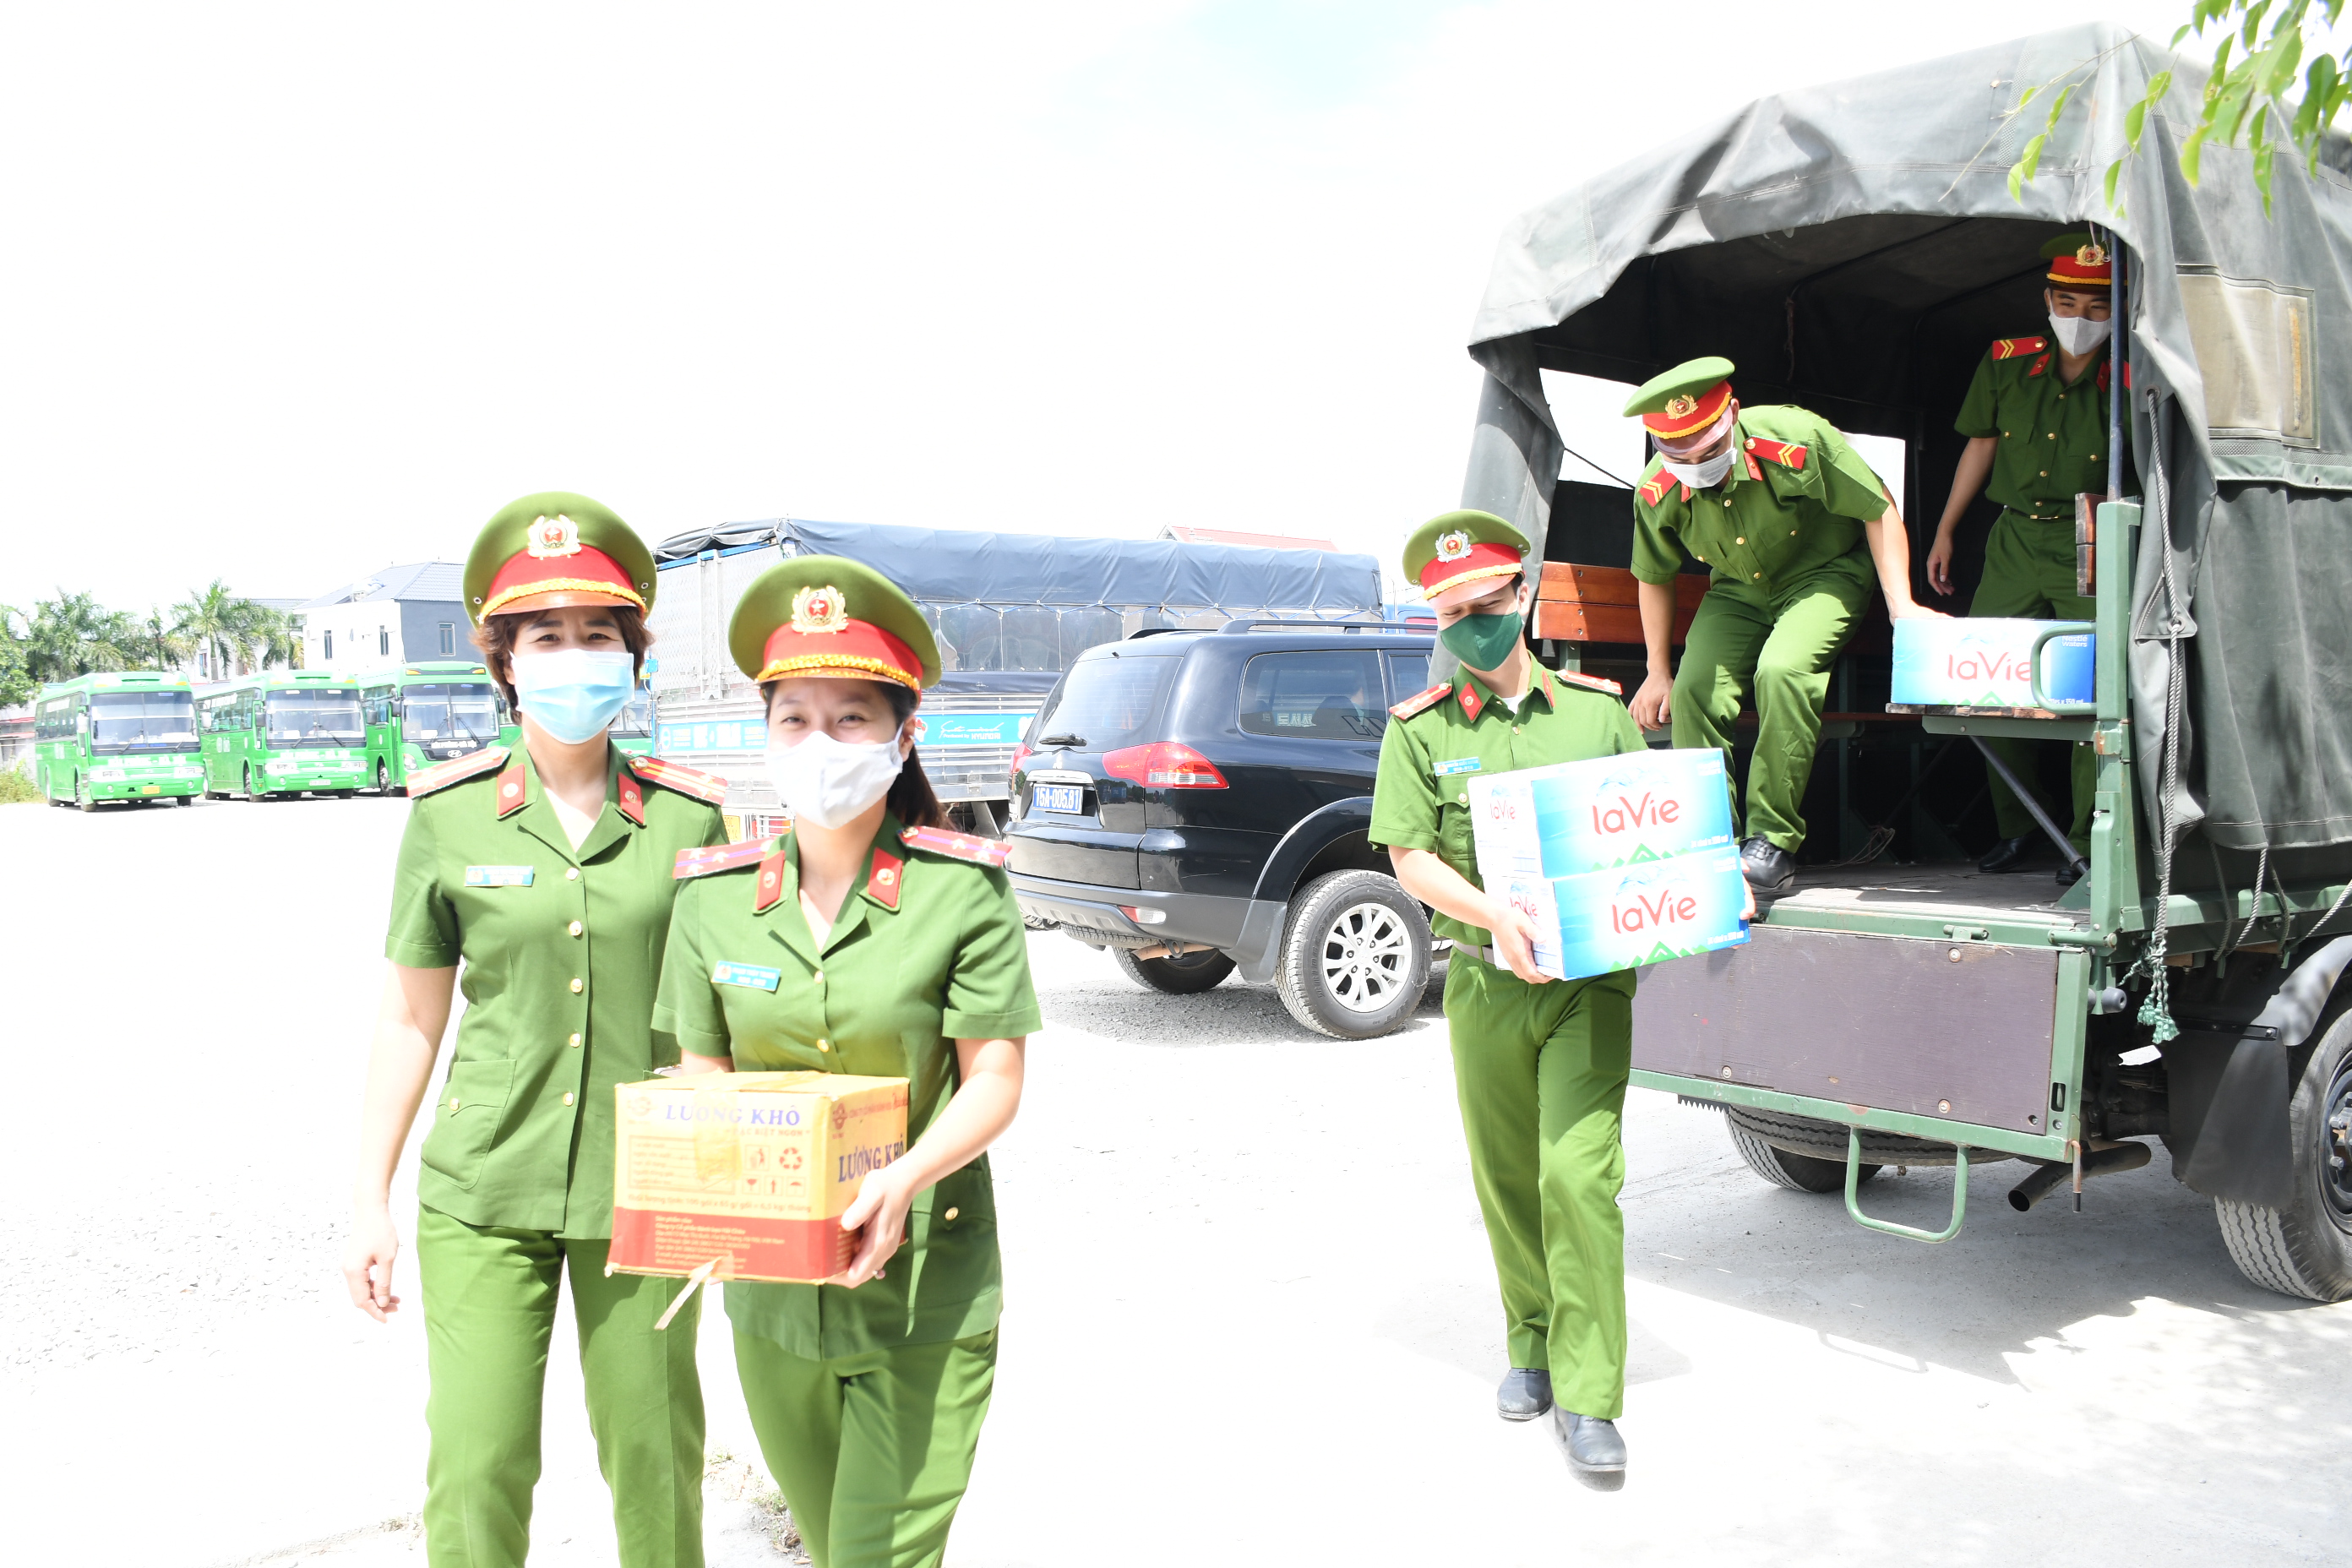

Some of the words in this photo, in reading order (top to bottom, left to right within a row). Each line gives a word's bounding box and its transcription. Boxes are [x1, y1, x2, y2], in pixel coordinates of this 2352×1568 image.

[1947, 651, 2032, 682] laVie
[1490, 799, 1516, 819] laVie
[1592, 792, 1680, 835] laVie
[1612, 890, 1696, 934] laVie
[665, 1102, 743, 1123] LƯƠNG
[750, 1105, 801, 1125] KHÔ
[839, 1144, 881, 1183] LƯƠNG
[885, 1133, 904, 1168] KHÔ
